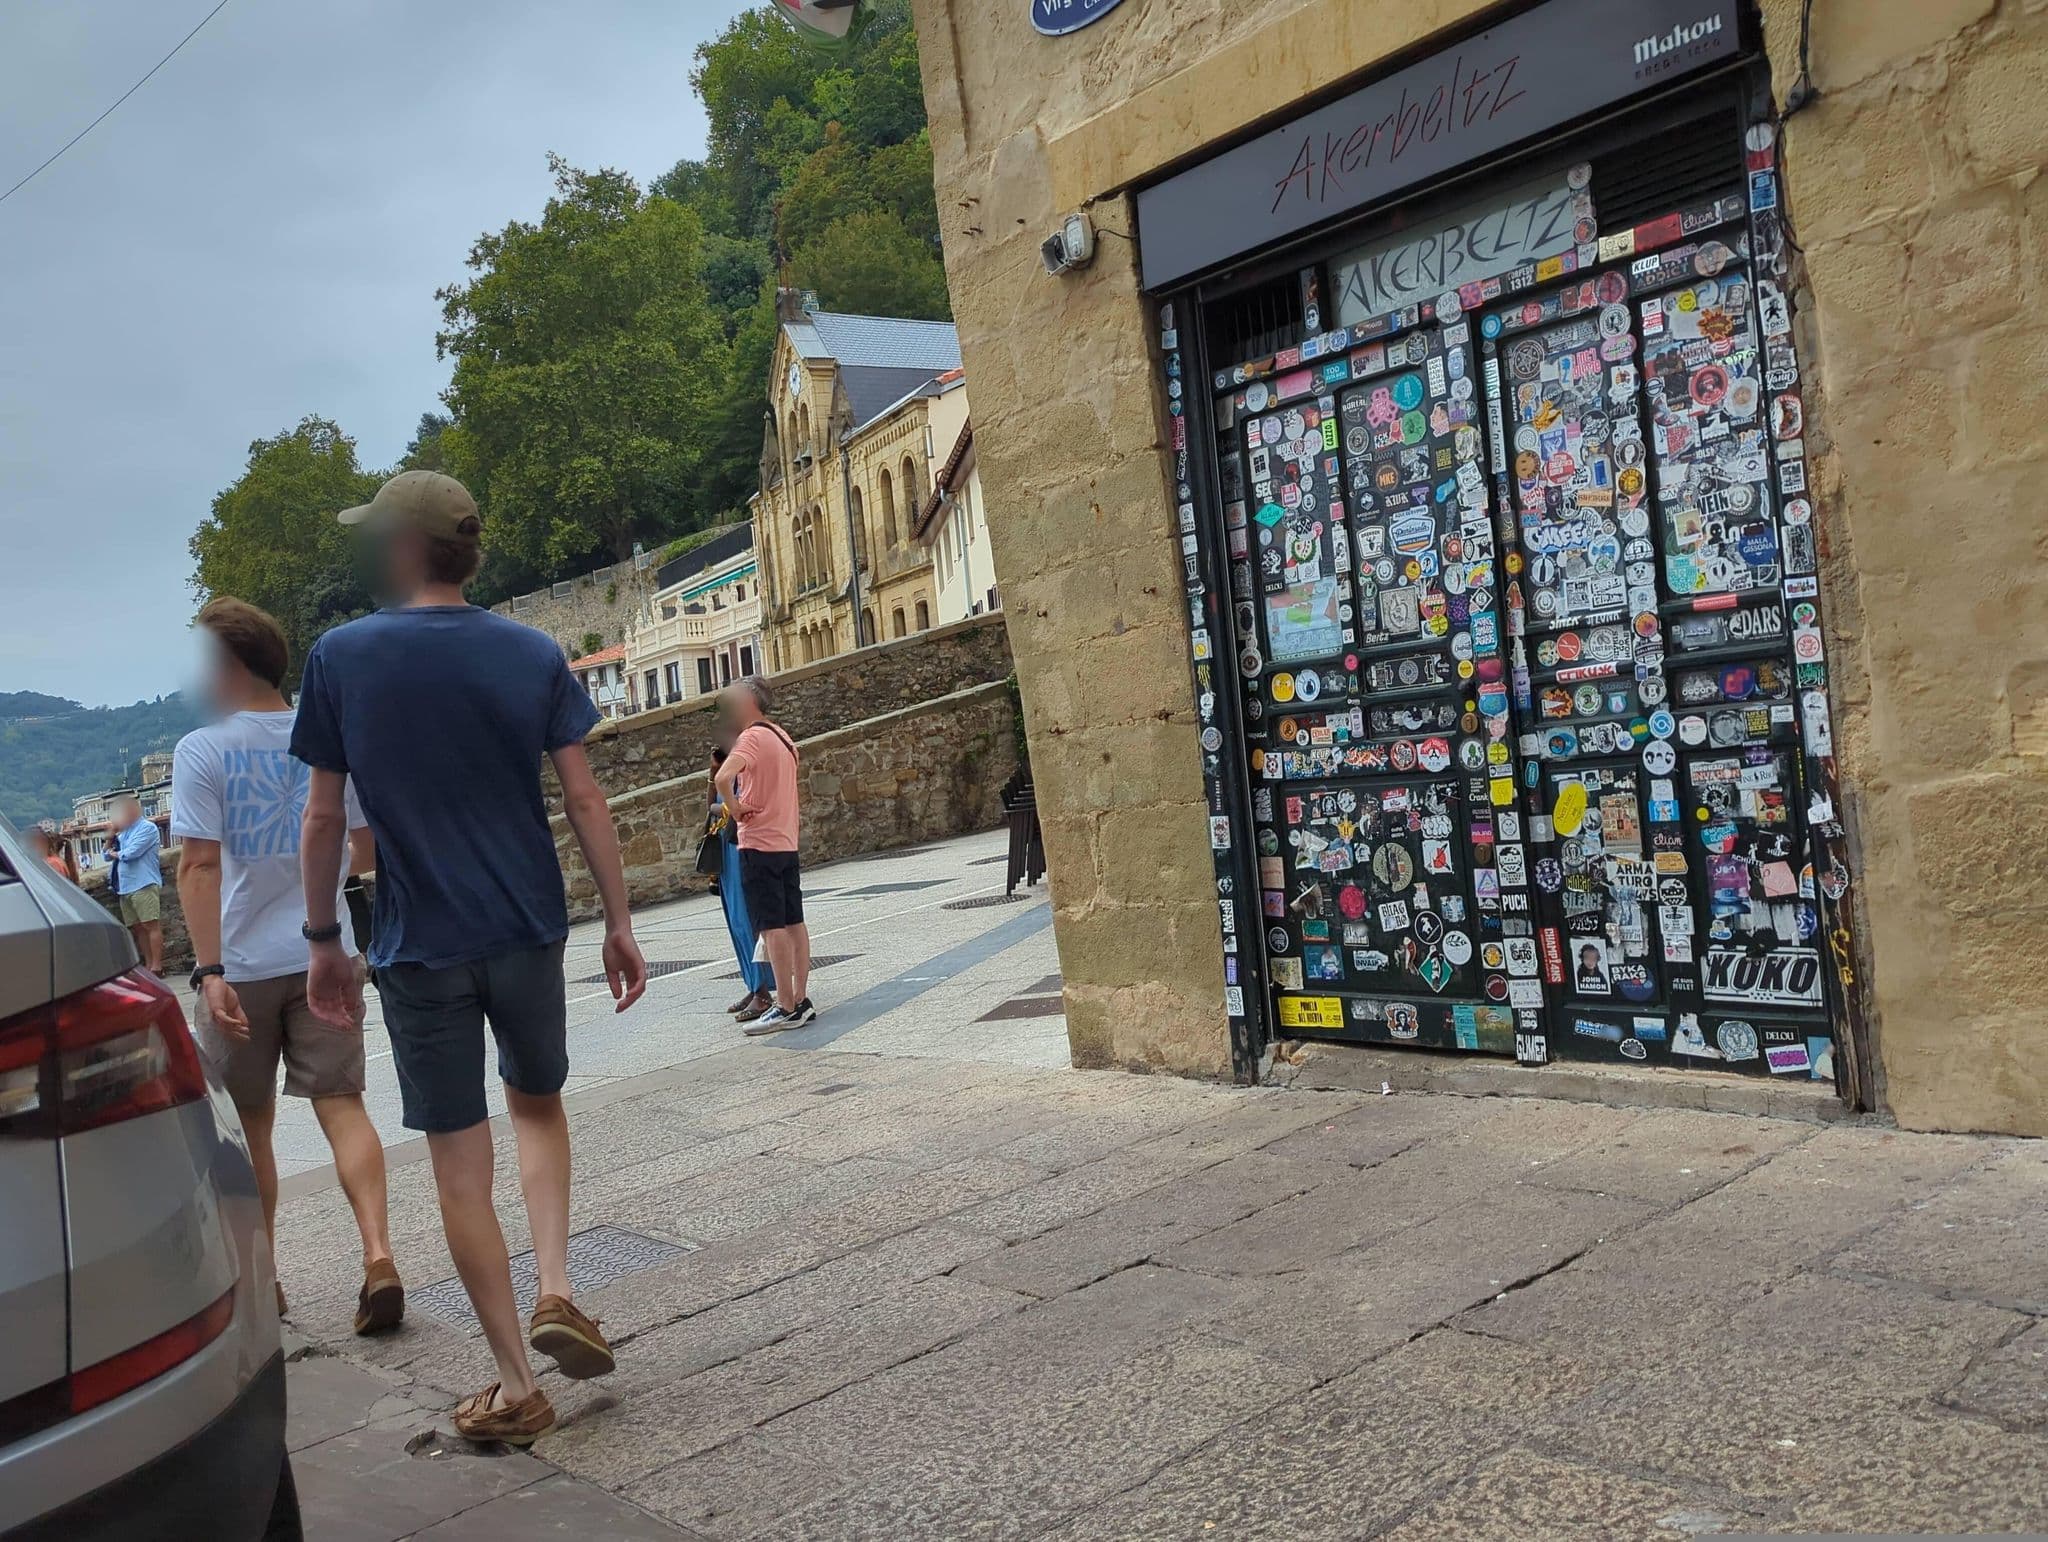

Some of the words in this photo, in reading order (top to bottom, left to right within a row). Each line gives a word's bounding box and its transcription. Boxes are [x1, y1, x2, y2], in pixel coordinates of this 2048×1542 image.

[1633, 13, 1722, 64] Mahou
[1272, 56, 1526, 214] Akerbeltz
[1339, 198, 1577, 312] AKERBELTZ
[1634, 257, 1659, 274] KLUP
[1510, 276, 1534, 291] 1312
[1743, 542, 1774, 553] GISSONA
[1746, 537, 1768, 546] MALA
[1616, 863, 1654, 875] ARMA
[1502, 893, 1528, 911] PUCH
[1562, 891, 1605, 912] SILENCE
[1611, 964, 1646, 975] BYKA
[1705, 953, 1818, 993] KOKO
[1580, 982, 1607, 991] HAMON
[1581, 976, 1601, 984] JOHN
[1765, 1031, 1795, 1041] DELOU
